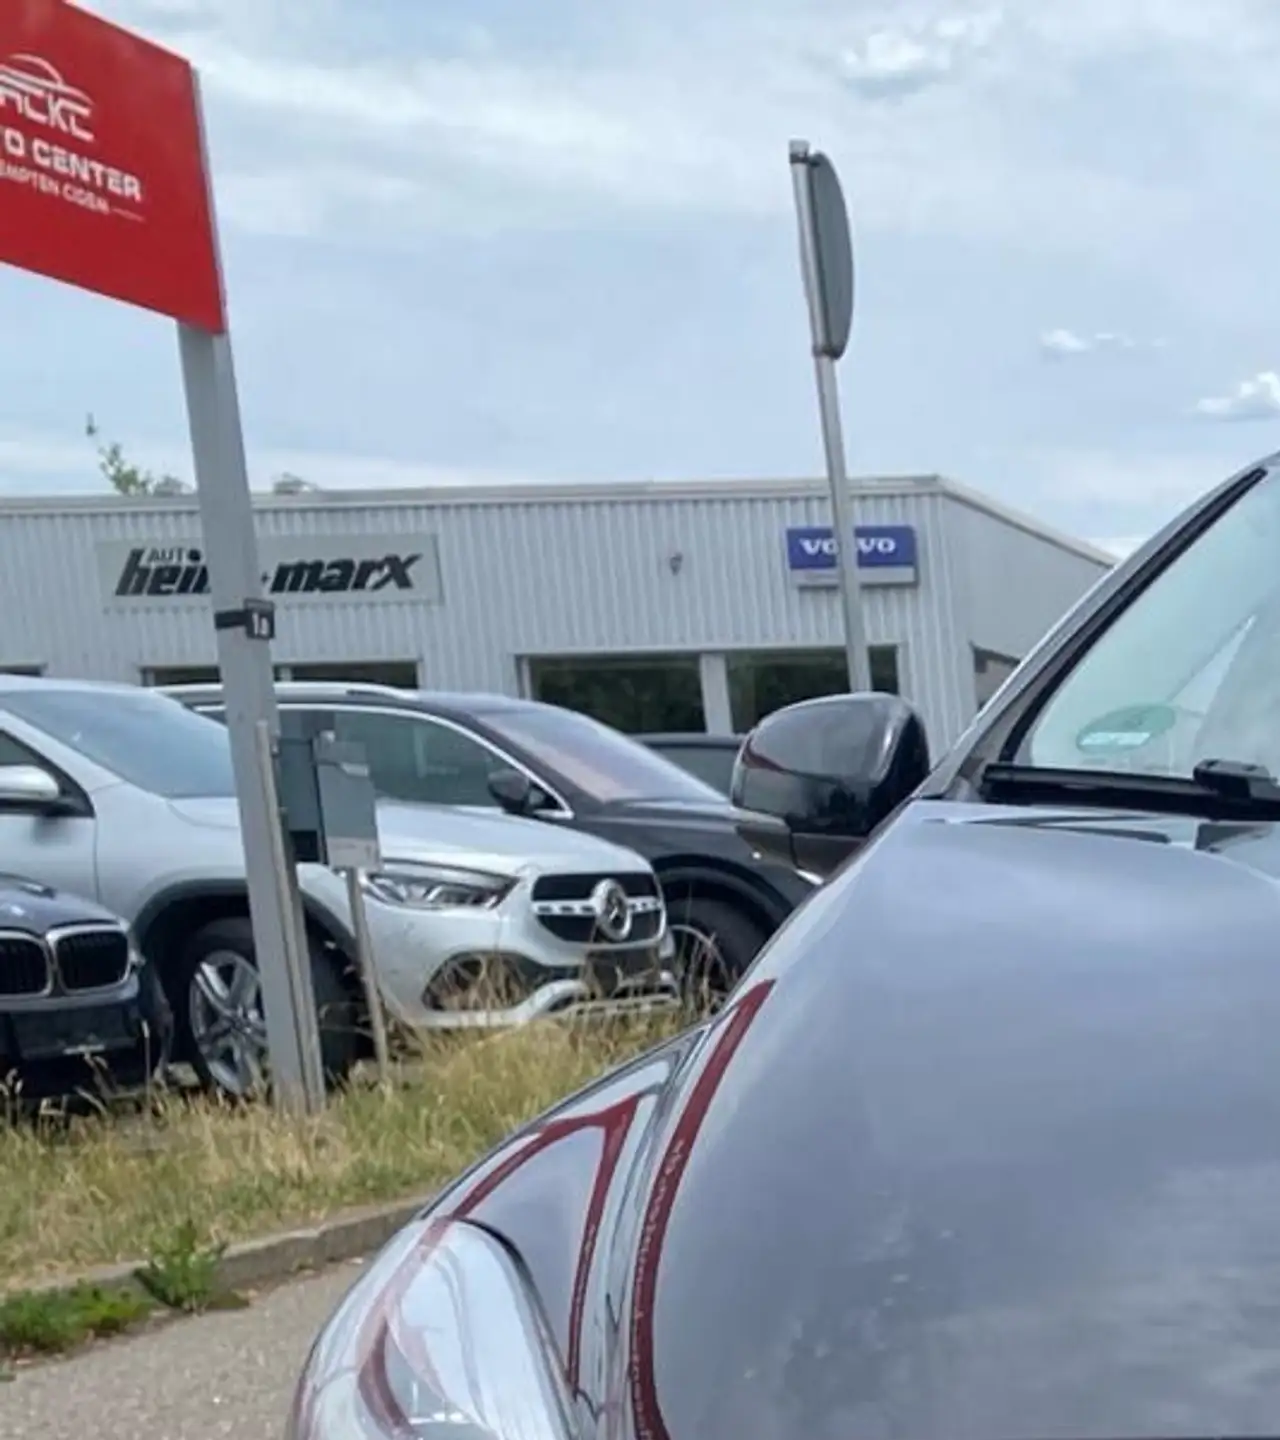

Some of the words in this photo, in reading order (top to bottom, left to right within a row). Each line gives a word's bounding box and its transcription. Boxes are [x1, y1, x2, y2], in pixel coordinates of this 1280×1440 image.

[32, 138, 142, 202] CENTER
[800, 537, 897, 556] VOVO
[270, 553, 423, 594] marx
